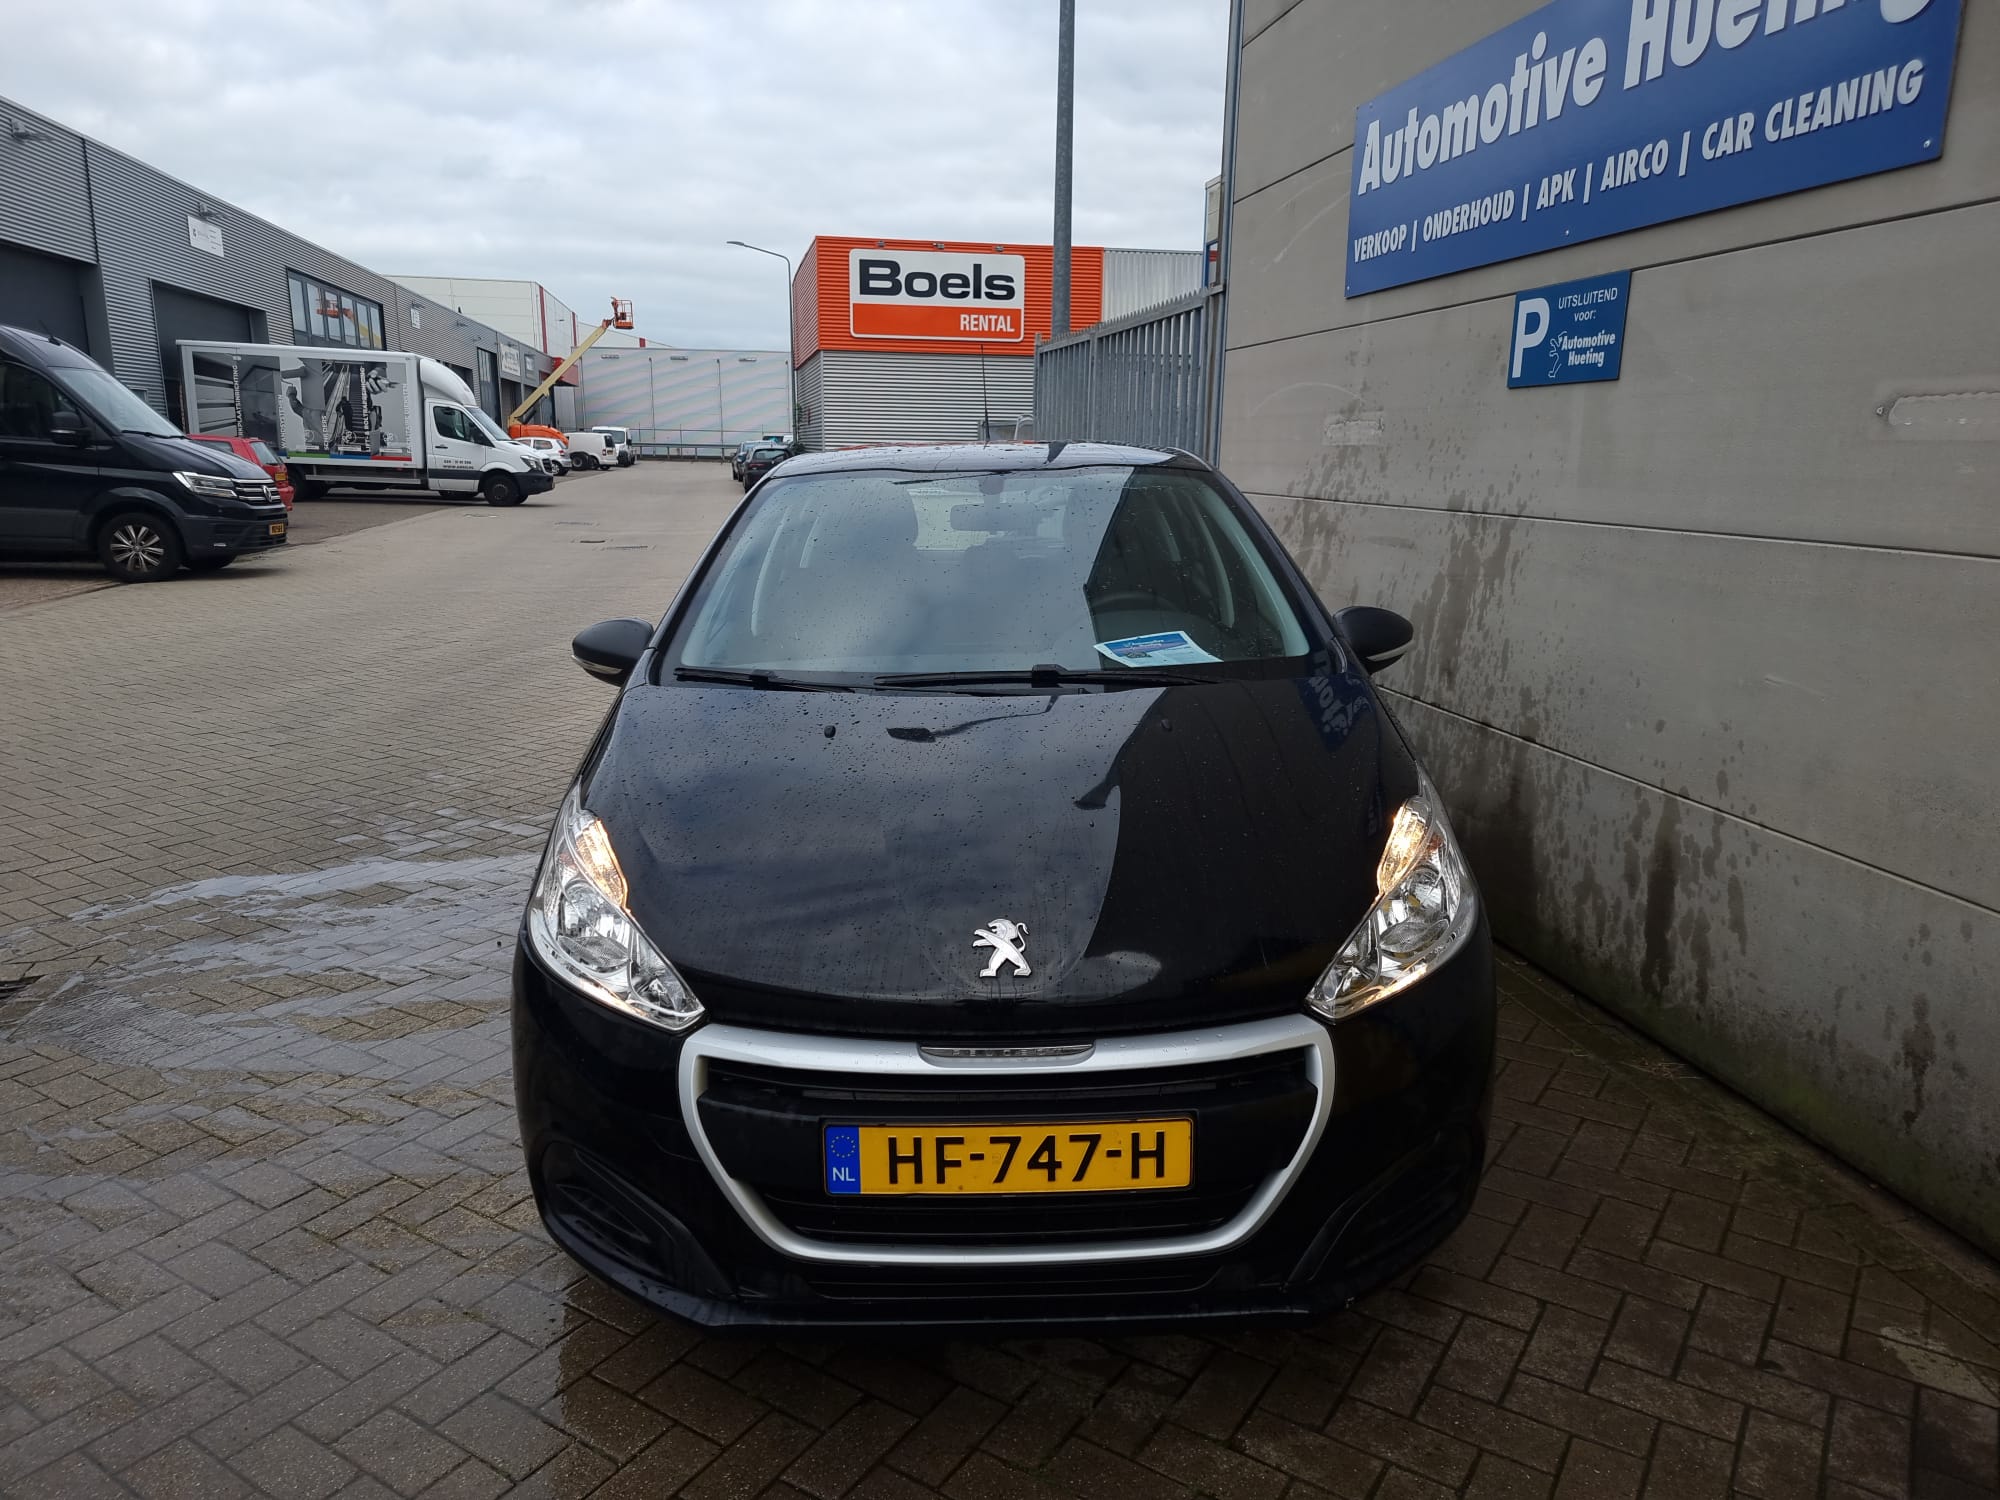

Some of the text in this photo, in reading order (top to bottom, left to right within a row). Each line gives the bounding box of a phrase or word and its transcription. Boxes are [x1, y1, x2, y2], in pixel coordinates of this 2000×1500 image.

[1358, 32, 1607, 195] Automotive
[1354, 225, 1406, 262] VERKOOP
[1423, 190, 1515, 242] ONDERHOUD
[1536, 168, 1577, 210] APK
[1600, 139, 1668, 191] AIRCO
[1702, 112, 1755, 161] CAR
[1765, 59, 1924, 143] CLEANING
[859, 258, 1016, 301] Boels
[1558, 287, 1618, 310] UITSLUITEND
[960, 313, 1015, 333] RENTAL
[1574, 309, 1597, 322] voor:
[1512, 298, 1550, 378] P
[1561, 329, 1616, 351] Automotive
[1568, 348, 1605, 368] Hueting
[832, 1131, 1166, 1184] NL HF-747-H
